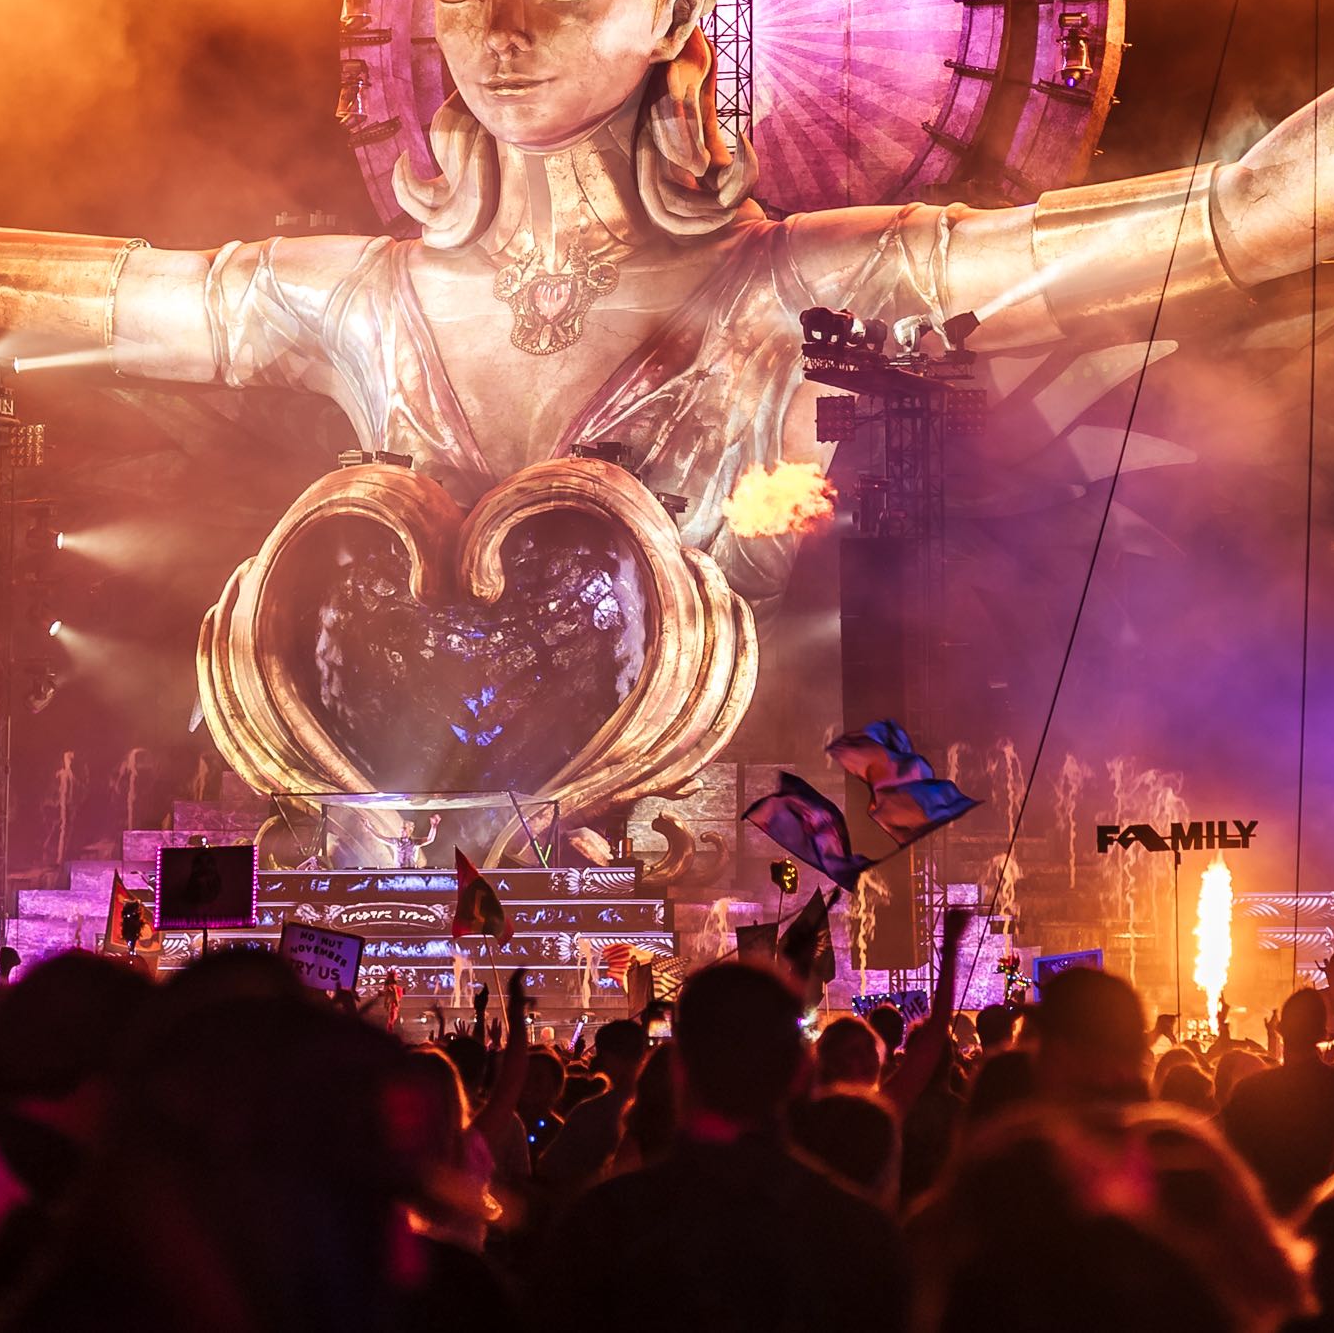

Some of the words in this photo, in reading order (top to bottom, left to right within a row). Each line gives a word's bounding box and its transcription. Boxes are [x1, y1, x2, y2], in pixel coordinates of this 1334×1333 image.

[1096, 820, 1259, 854] FAMILY
[299, 931, 315, 942] NO
[320, 937, 343, 950] NUT
[290, 944, 347, 968] NOVEMBER
[318, 966, 340, 981] US
